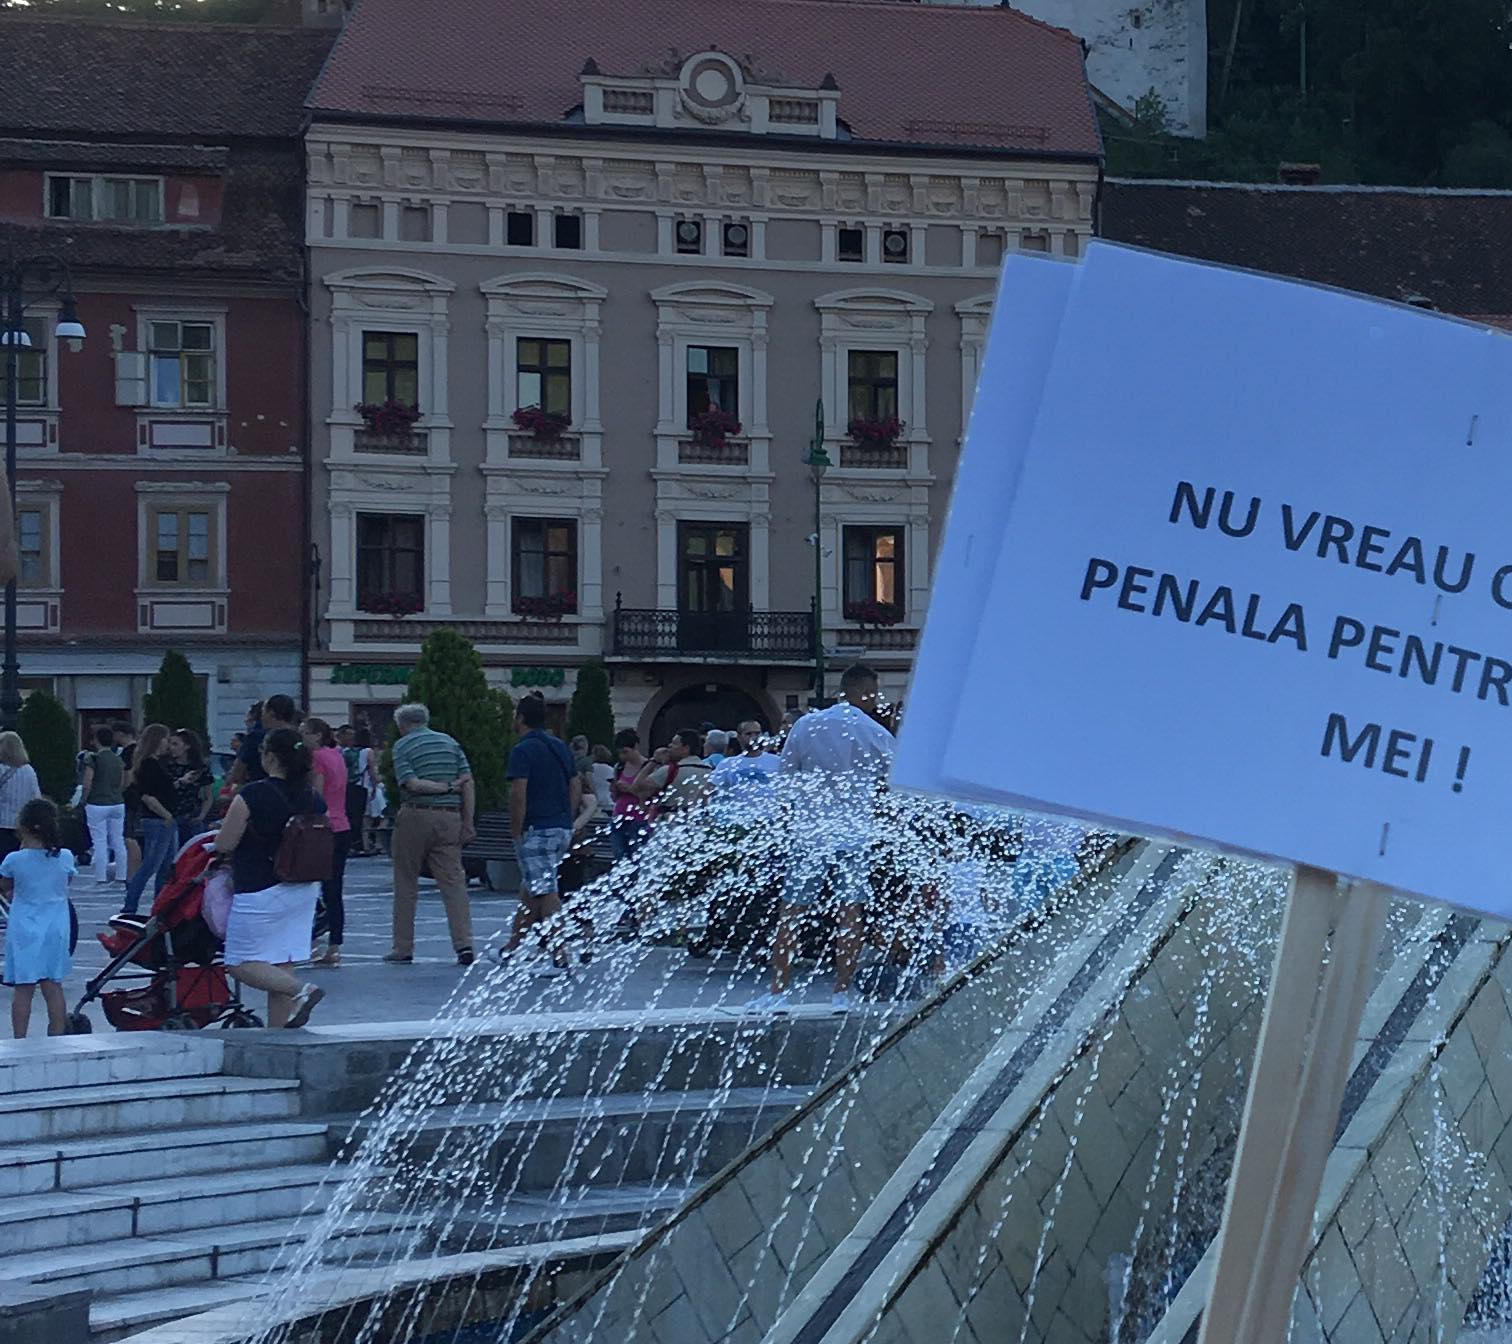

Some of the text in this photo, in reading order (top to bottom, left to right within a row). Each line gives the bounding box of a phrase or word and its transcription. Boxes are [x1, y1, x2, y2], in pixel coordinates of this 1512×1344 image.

[1167, 480, 1262, 539] NU
[1281, 503, 1476, 595] VREAU
[1079, 557, 1309, 653] PENALA
[1320, 712, 1434, 784] MEI
